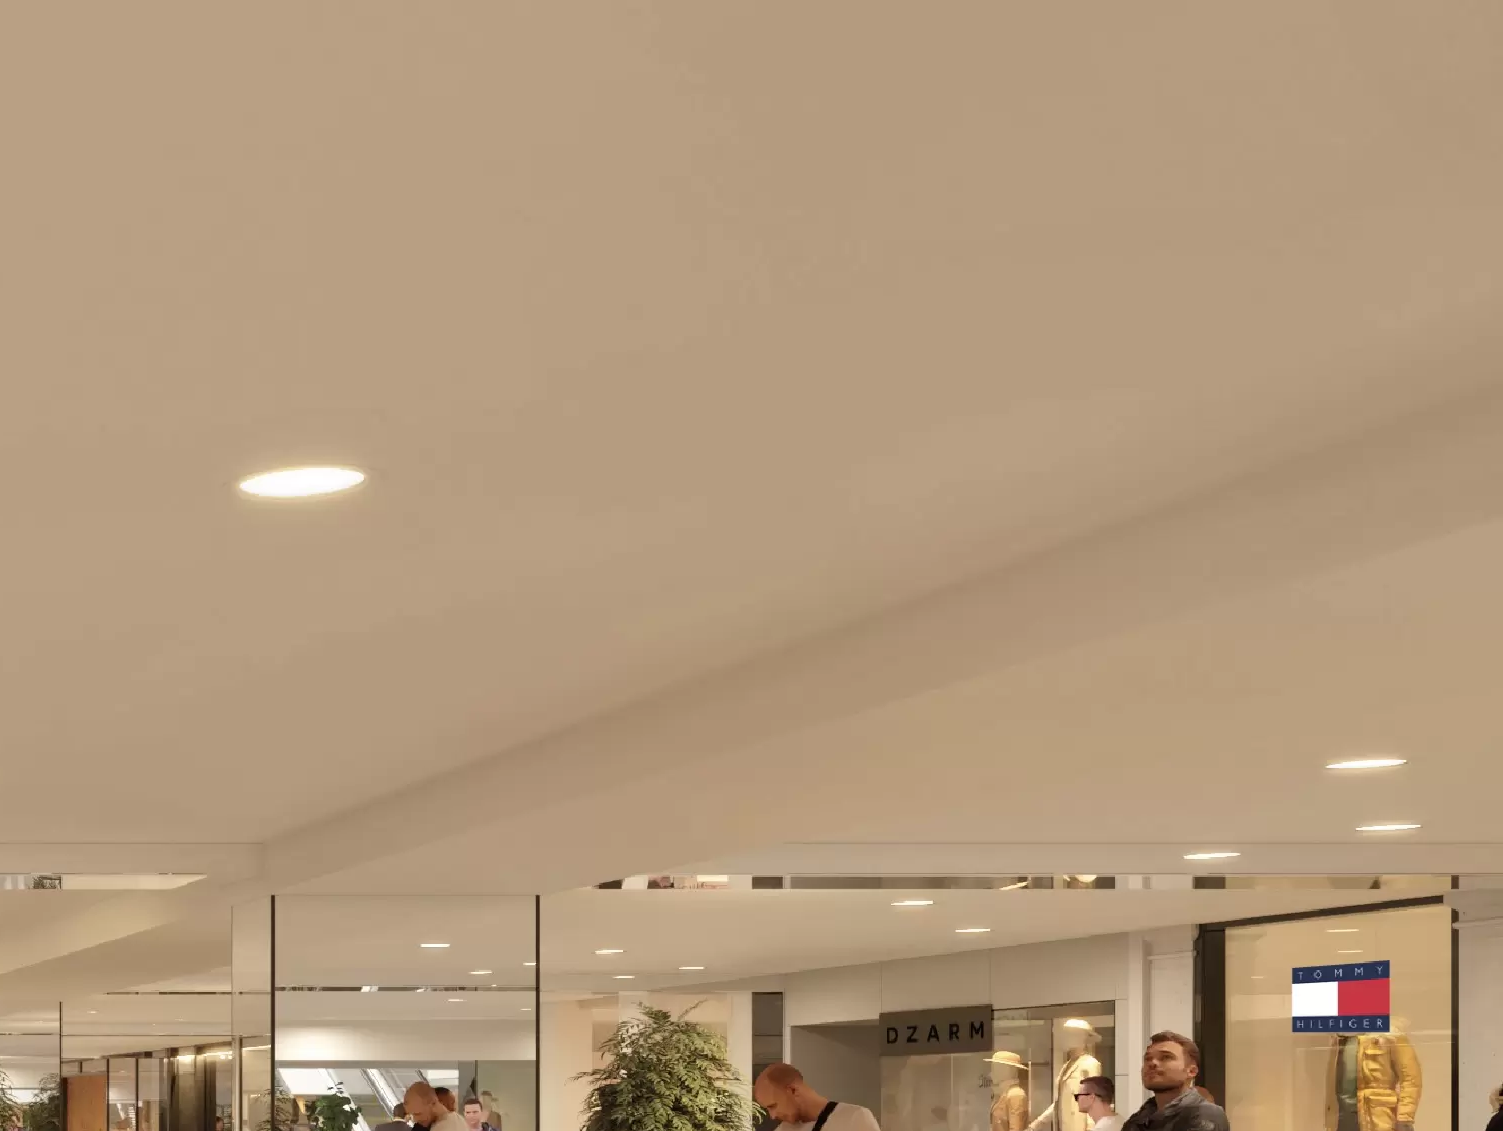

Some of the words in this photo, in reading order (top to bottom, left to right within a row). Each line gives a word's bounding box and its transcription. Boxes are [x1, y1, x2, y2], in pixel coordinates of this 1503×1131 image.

[1297, 965, 1383, 981] TOMMY
[1296, 1018, 1383, 1029] HILFIGER
[886, 1020, 985, 1044] DZARM
